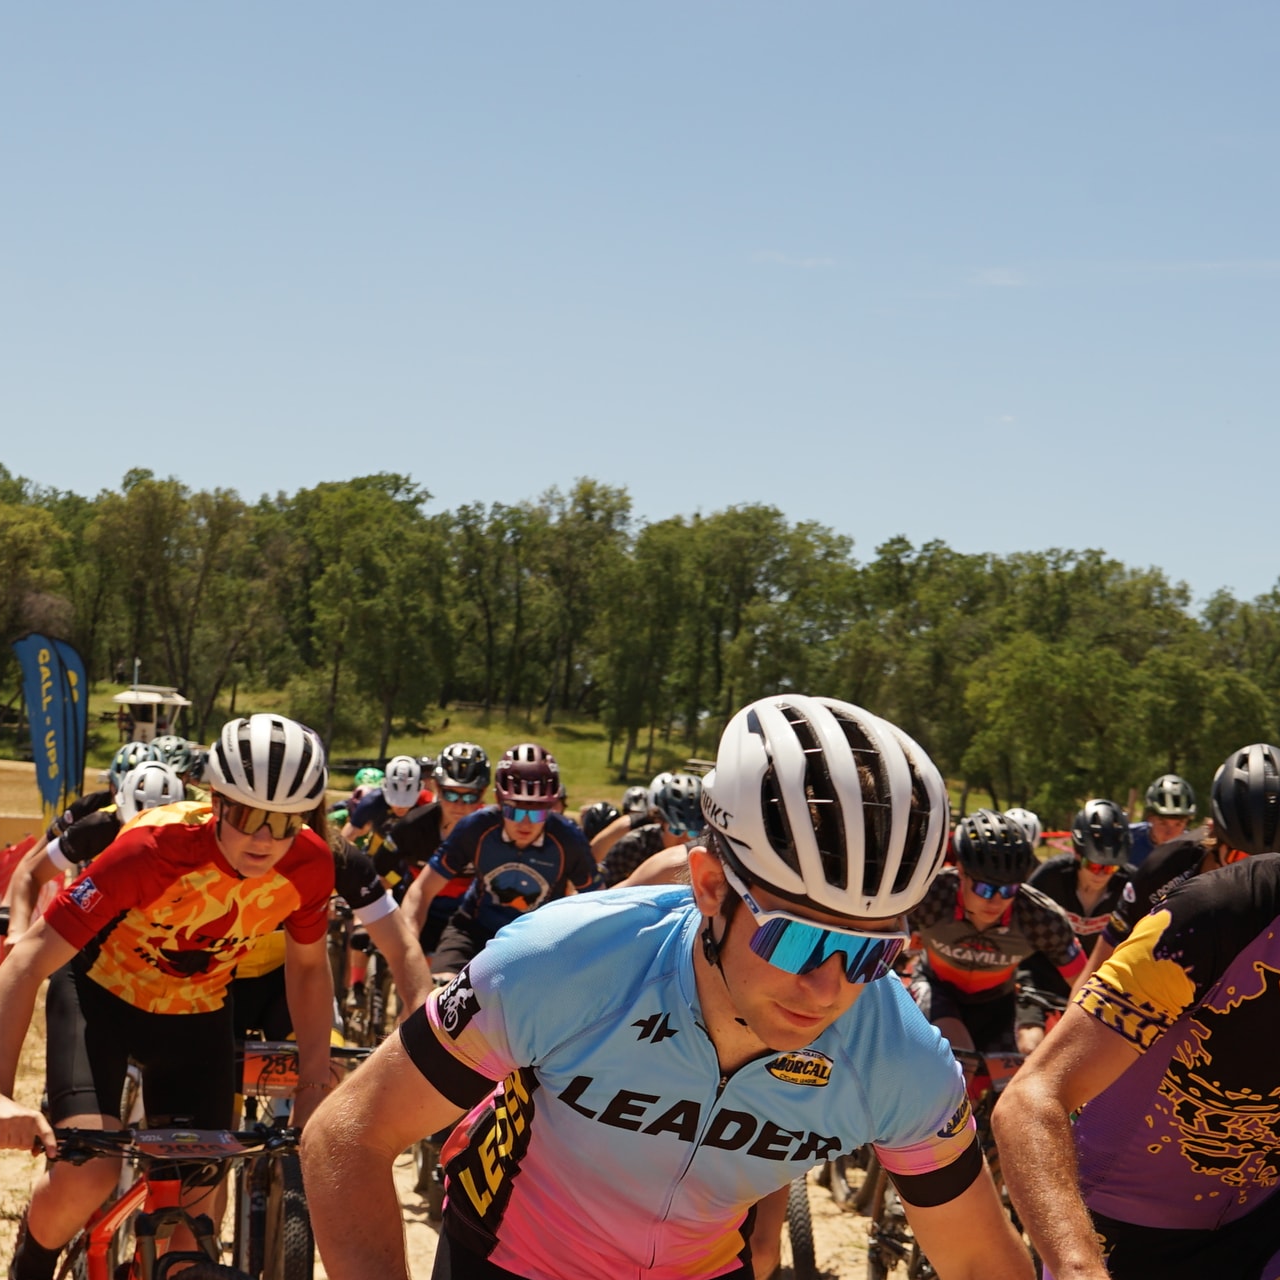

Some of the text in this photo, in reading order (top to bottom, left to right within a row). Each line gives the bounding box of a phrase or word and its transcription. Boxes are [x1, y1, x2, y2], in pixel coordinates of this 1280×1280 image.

[930, 938, 1024, 966] VACAVILLE
[438, 971, 468, 1005] NICA
[261, 1055, 299, 1075] 254
[557, 1075, 842, 1161] LEADER
